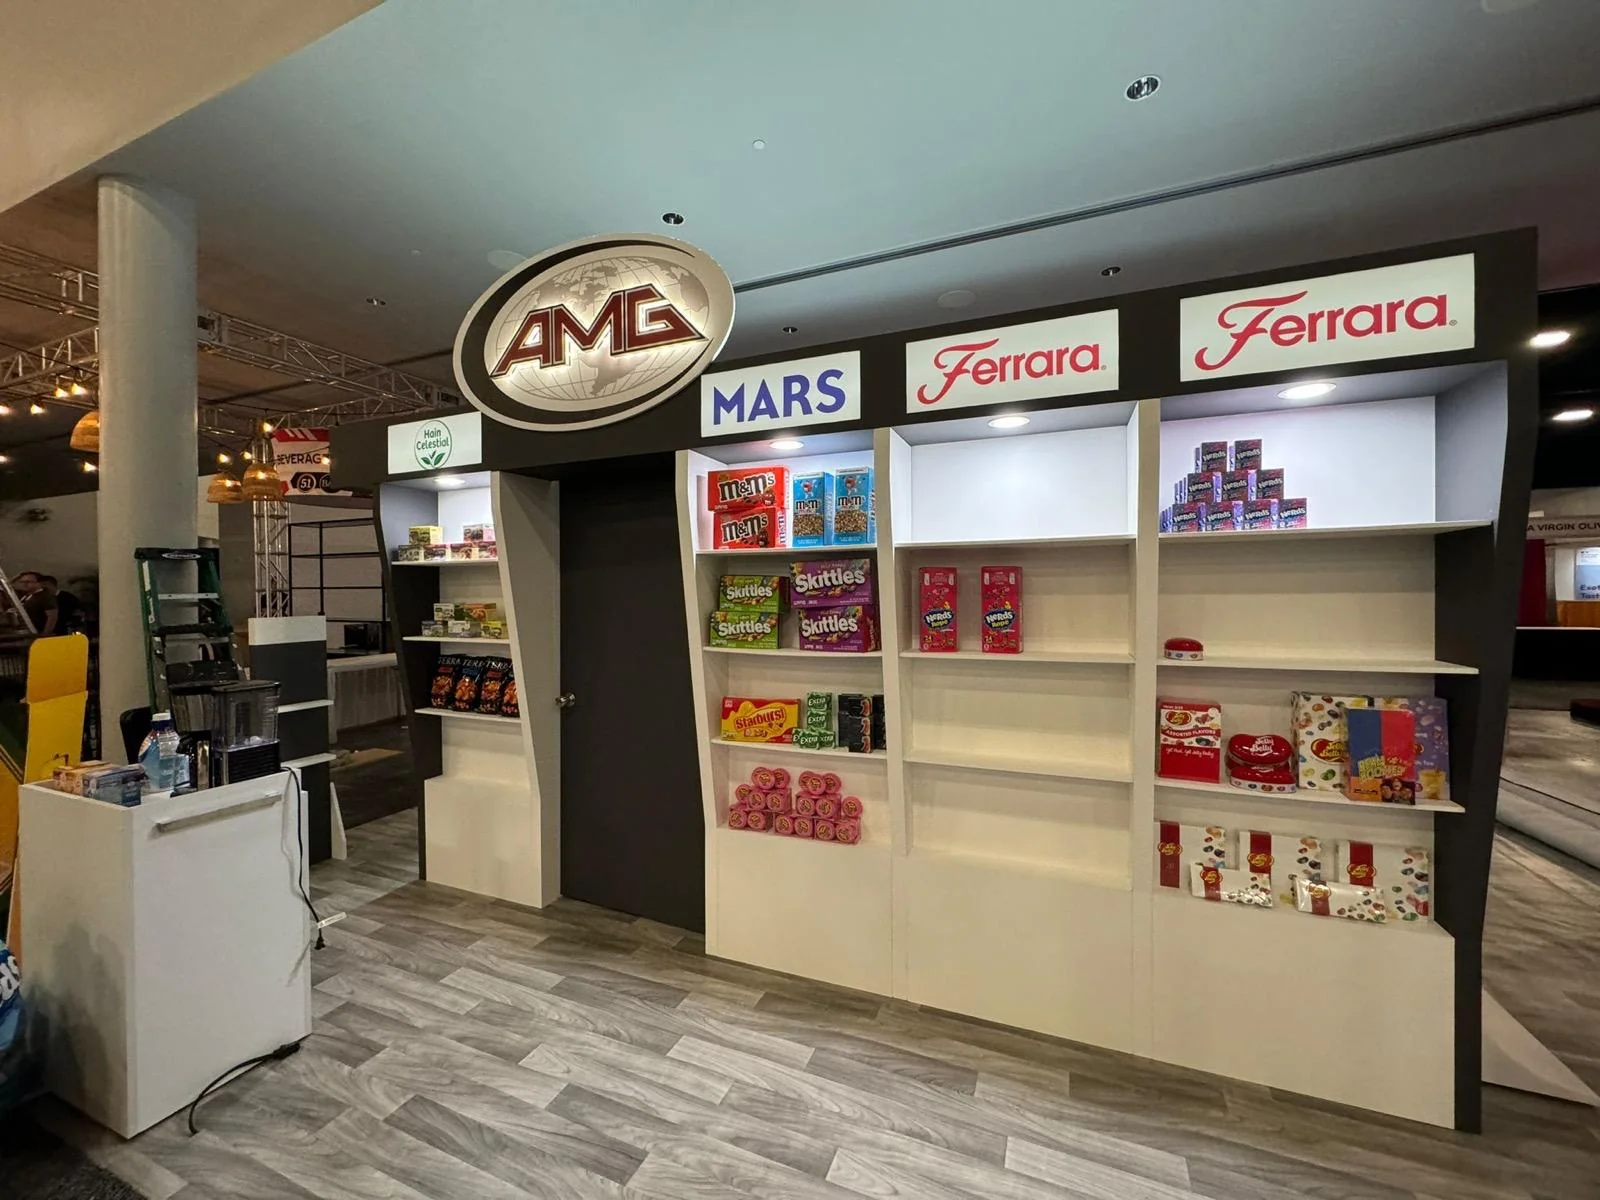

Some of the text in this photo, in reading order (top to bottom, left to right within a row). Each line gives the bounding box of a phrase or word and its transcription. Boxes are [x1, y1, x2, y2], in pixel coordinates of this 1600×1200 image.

[489, 283, 709, 379] AMG
[1194, 290, 1447, 371] Ferrara
[917, 338, 1099, 405] Ferrara
[714, 369, 846, 426] MARS
[416, 437, 450, 450] Celestial
[423, 428, 441, 439] Hain
[300, 478, 312, 489] 51
[1537, 523, 1575, 531] VIRGIN
[795, 568, 865, 593] Skittles
[727, 584, 773, 600] Skittles
[718, 620, 771, 637] Skittles
[801, 615, 858, 637] Skittles
[735, 708, 785, 729] Starburst
